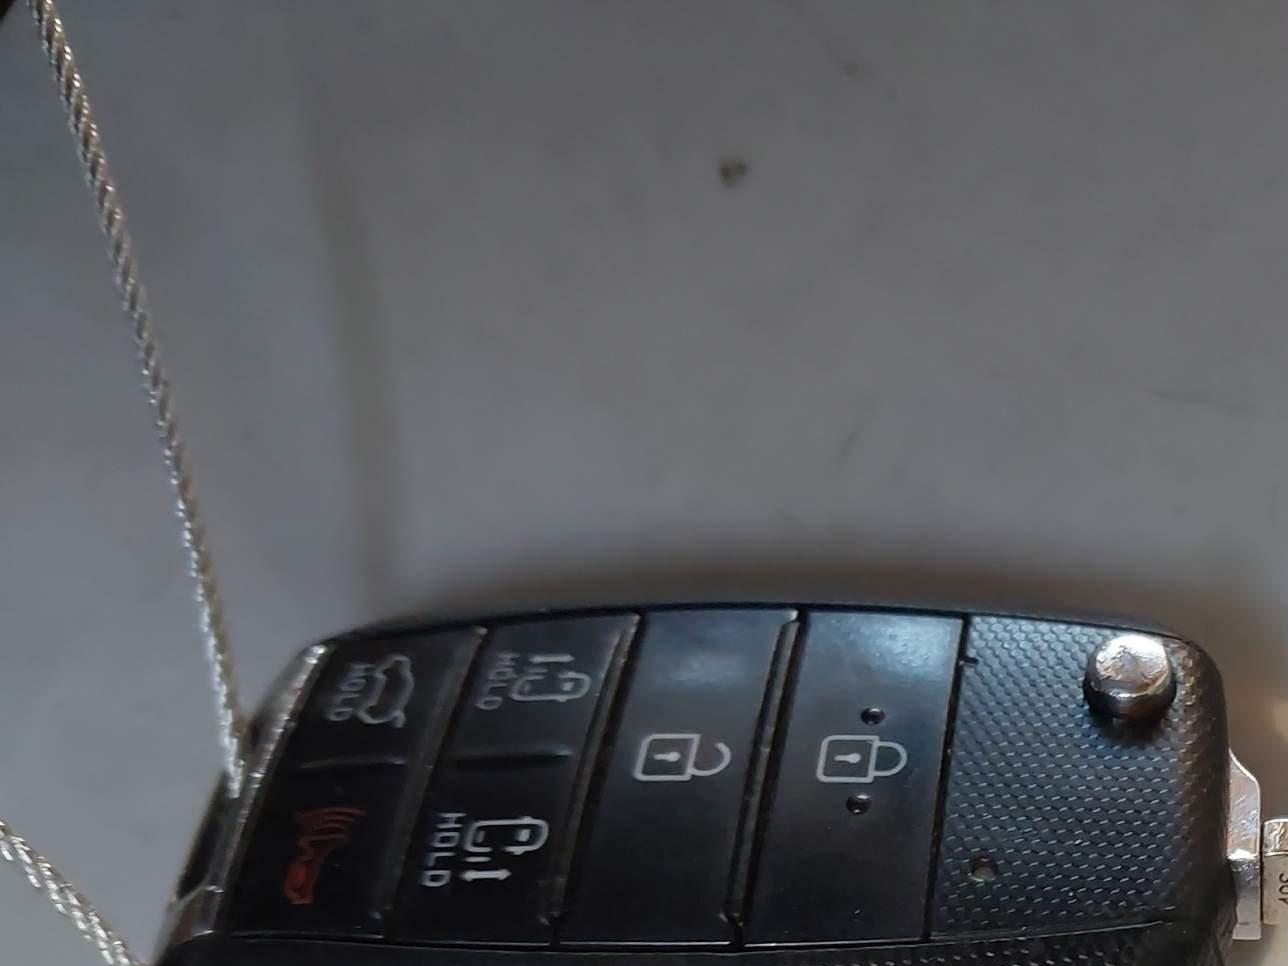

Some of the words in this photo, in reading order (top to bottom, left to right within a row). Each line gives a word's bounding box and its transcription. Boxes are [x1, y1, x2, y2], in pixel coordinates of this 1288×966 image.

[327, 662, 373, 721] HOLD
[475, 653, 516, 710] HOLD
[421, 812, 468, 888] HOLD
